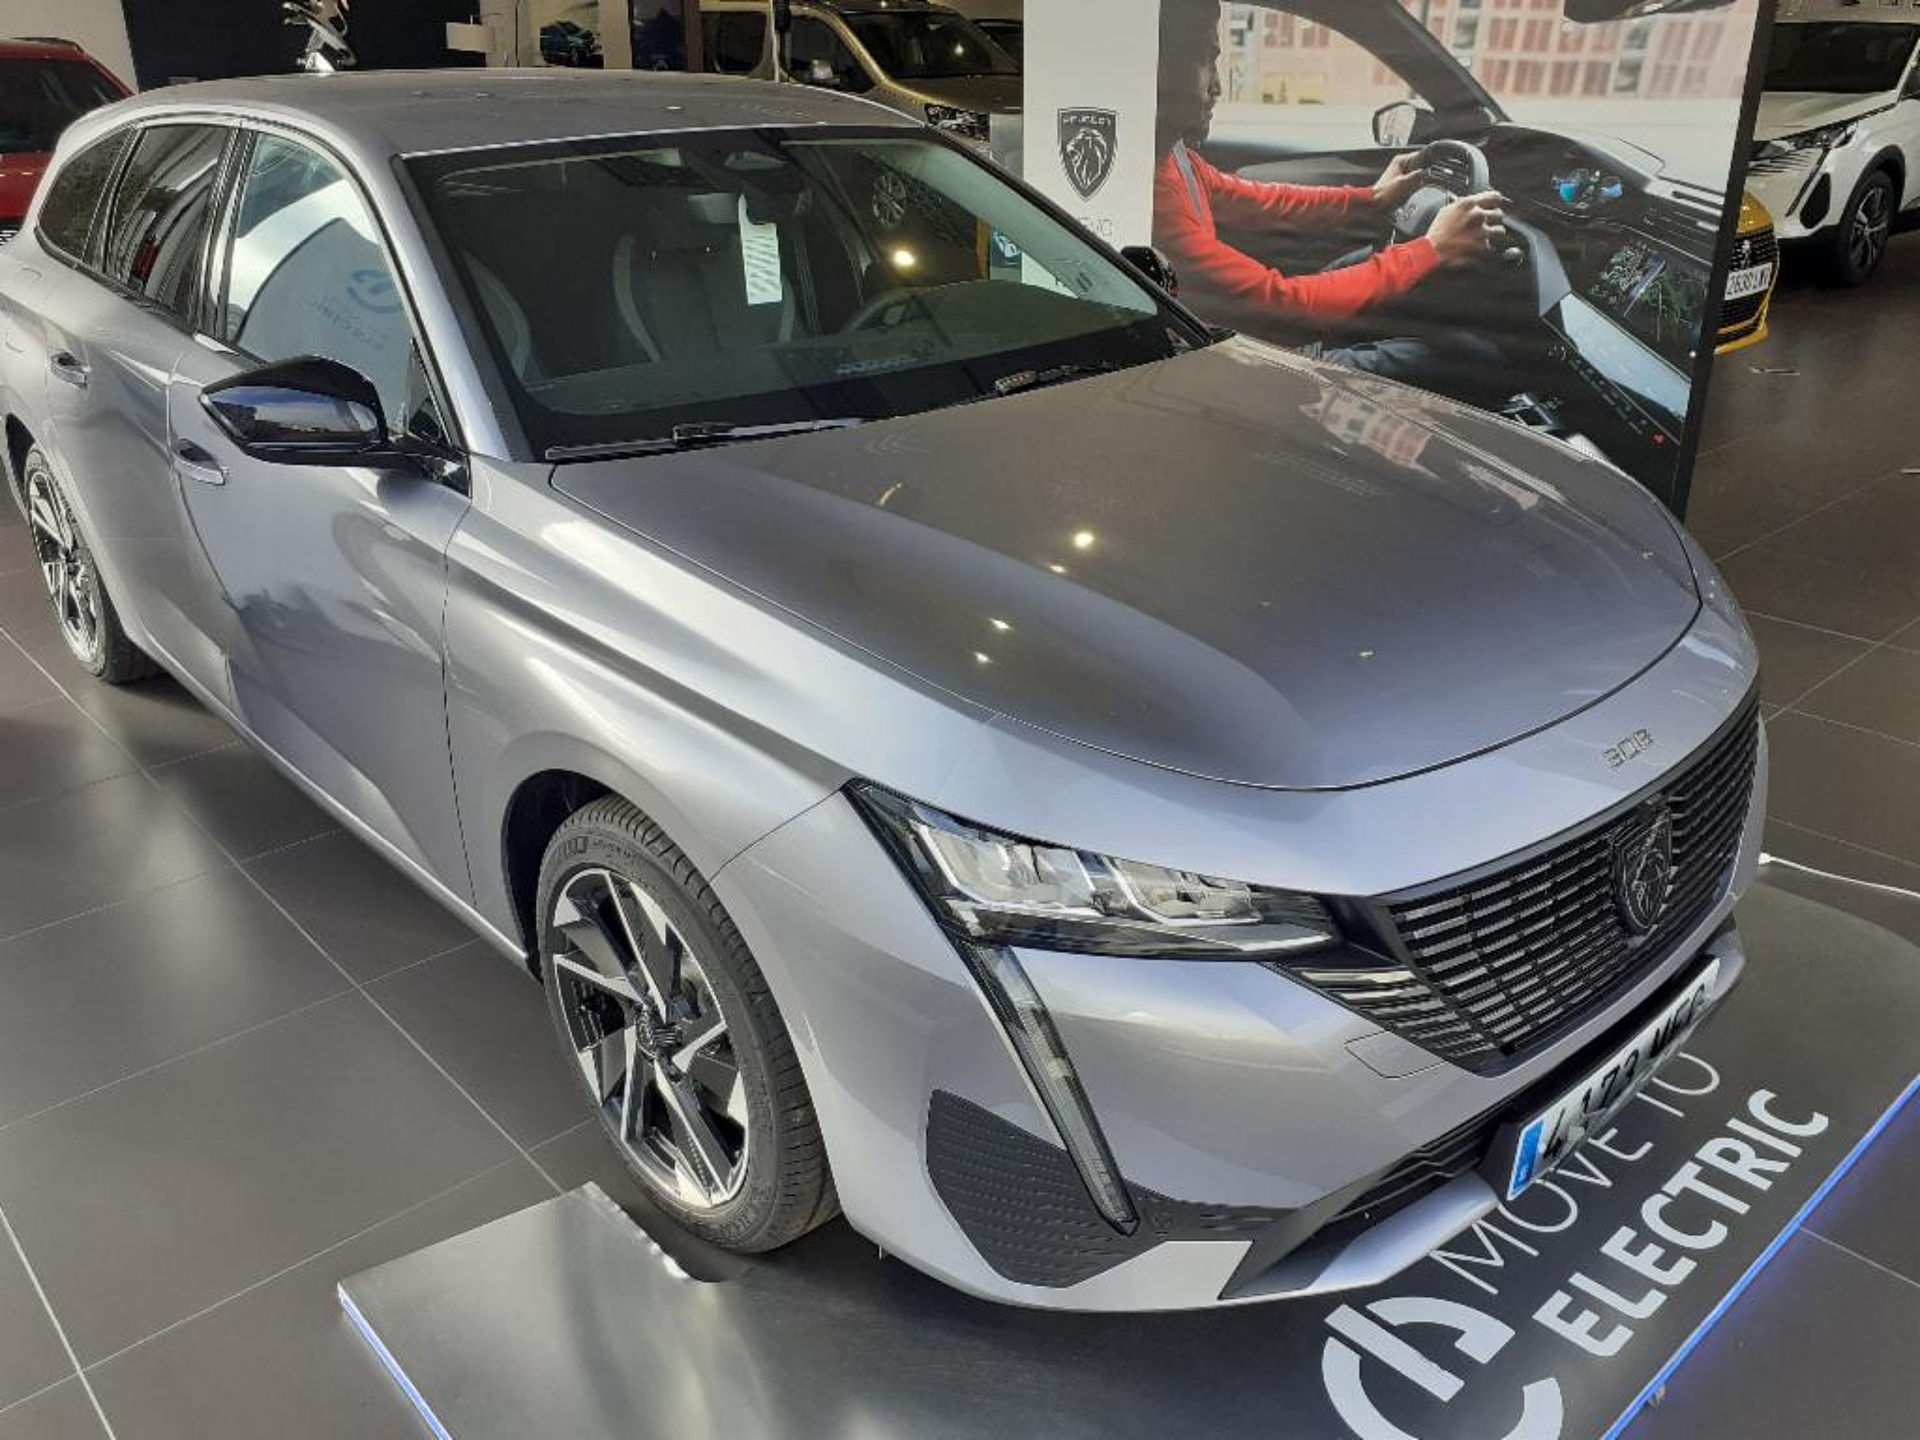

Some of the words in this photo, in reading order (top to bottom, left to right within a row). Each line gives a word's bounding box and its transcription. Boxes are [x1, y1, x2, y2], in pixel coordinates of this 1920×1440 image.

[1604, 729, 1653, 768] 308
[1543, 1049, 1640, 1160] 4173
[1427, 1128, 1654, 1294] MOVE
[1532, 1088, 1829, 1357] ELECTRIC
